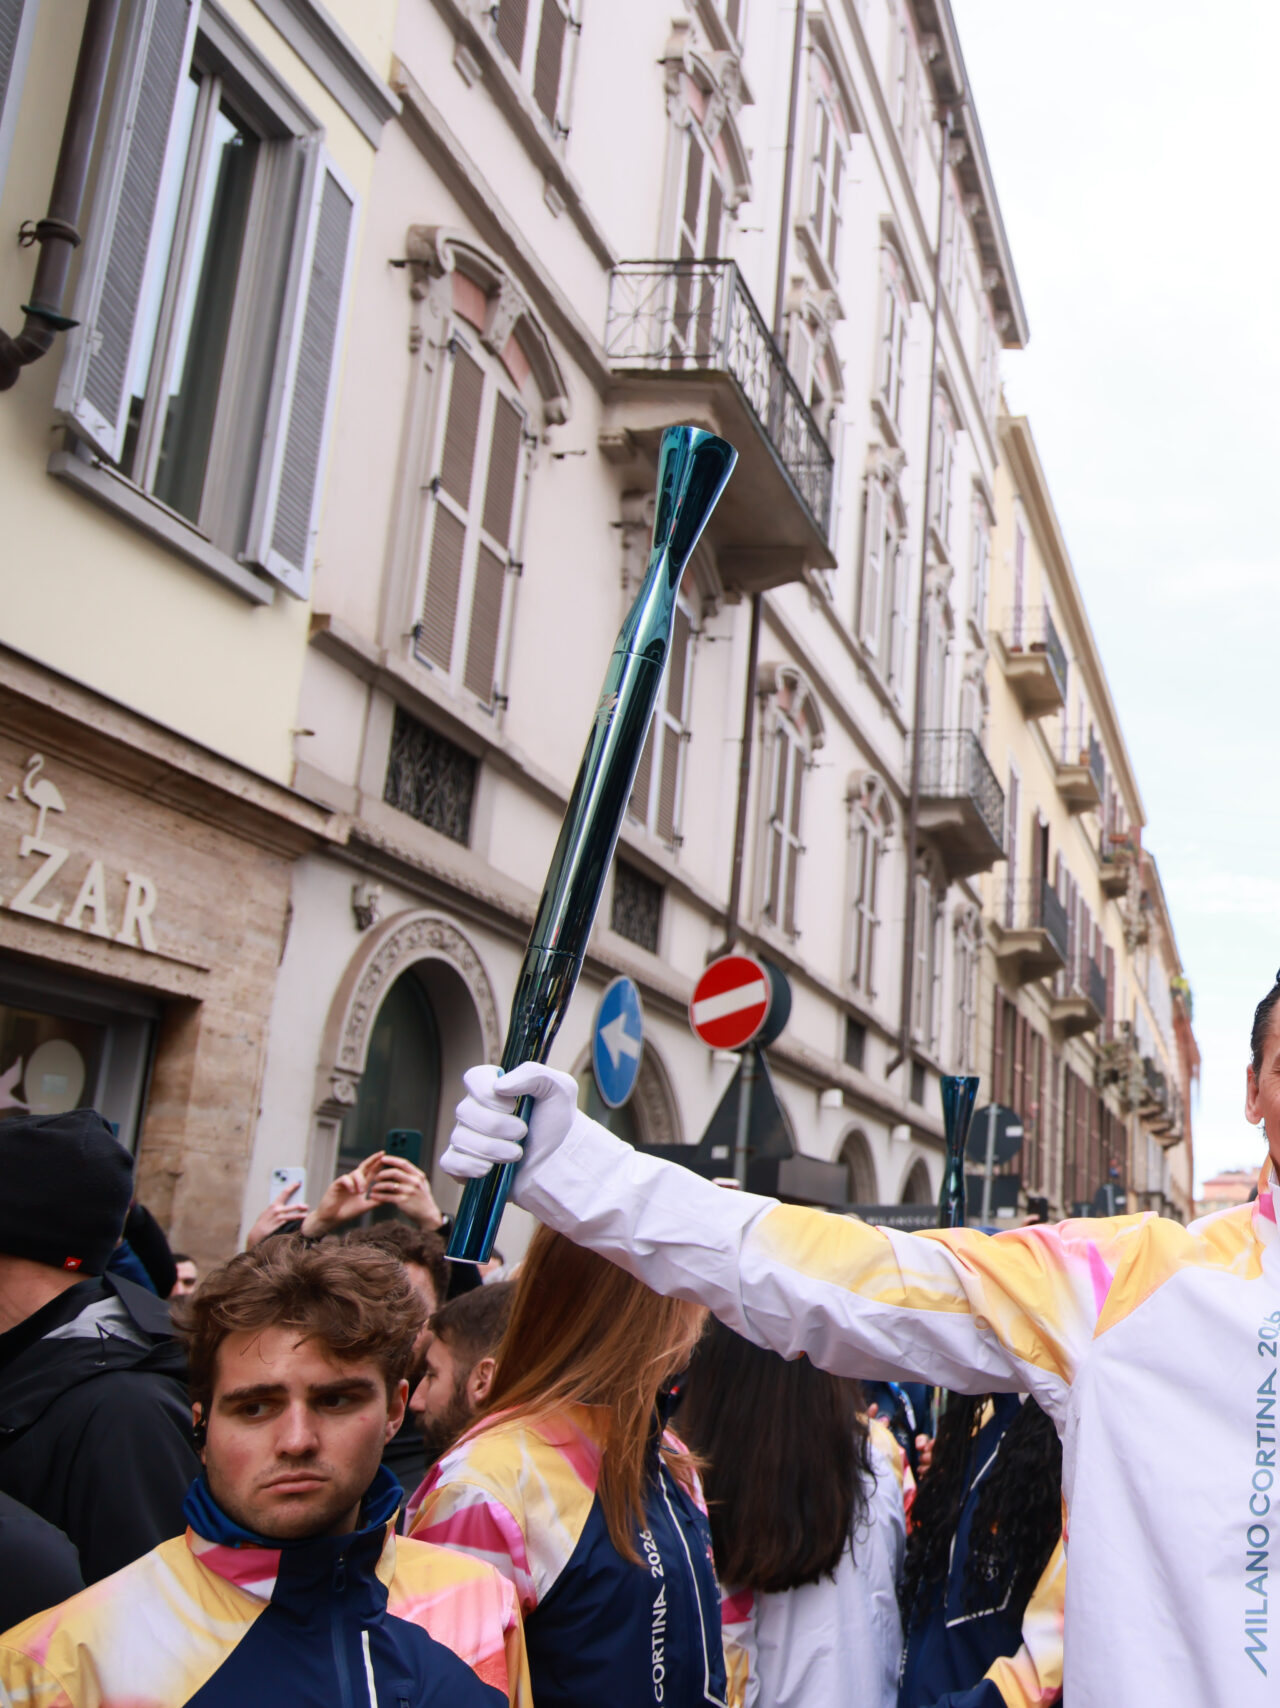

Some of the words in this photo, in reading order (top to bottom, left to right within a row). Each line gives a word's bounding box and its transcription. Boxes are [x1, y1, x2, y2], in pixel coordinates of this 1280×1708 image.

[0, 834, 157, 951] ZAR
[1249, 1368, 1278, 1517] CORTINA
[639, 1529, 664, 1578] 2026
[1244, 1524, 1270, 1678] MILANO
[652, 1583, 667, 1702] CORTINA
